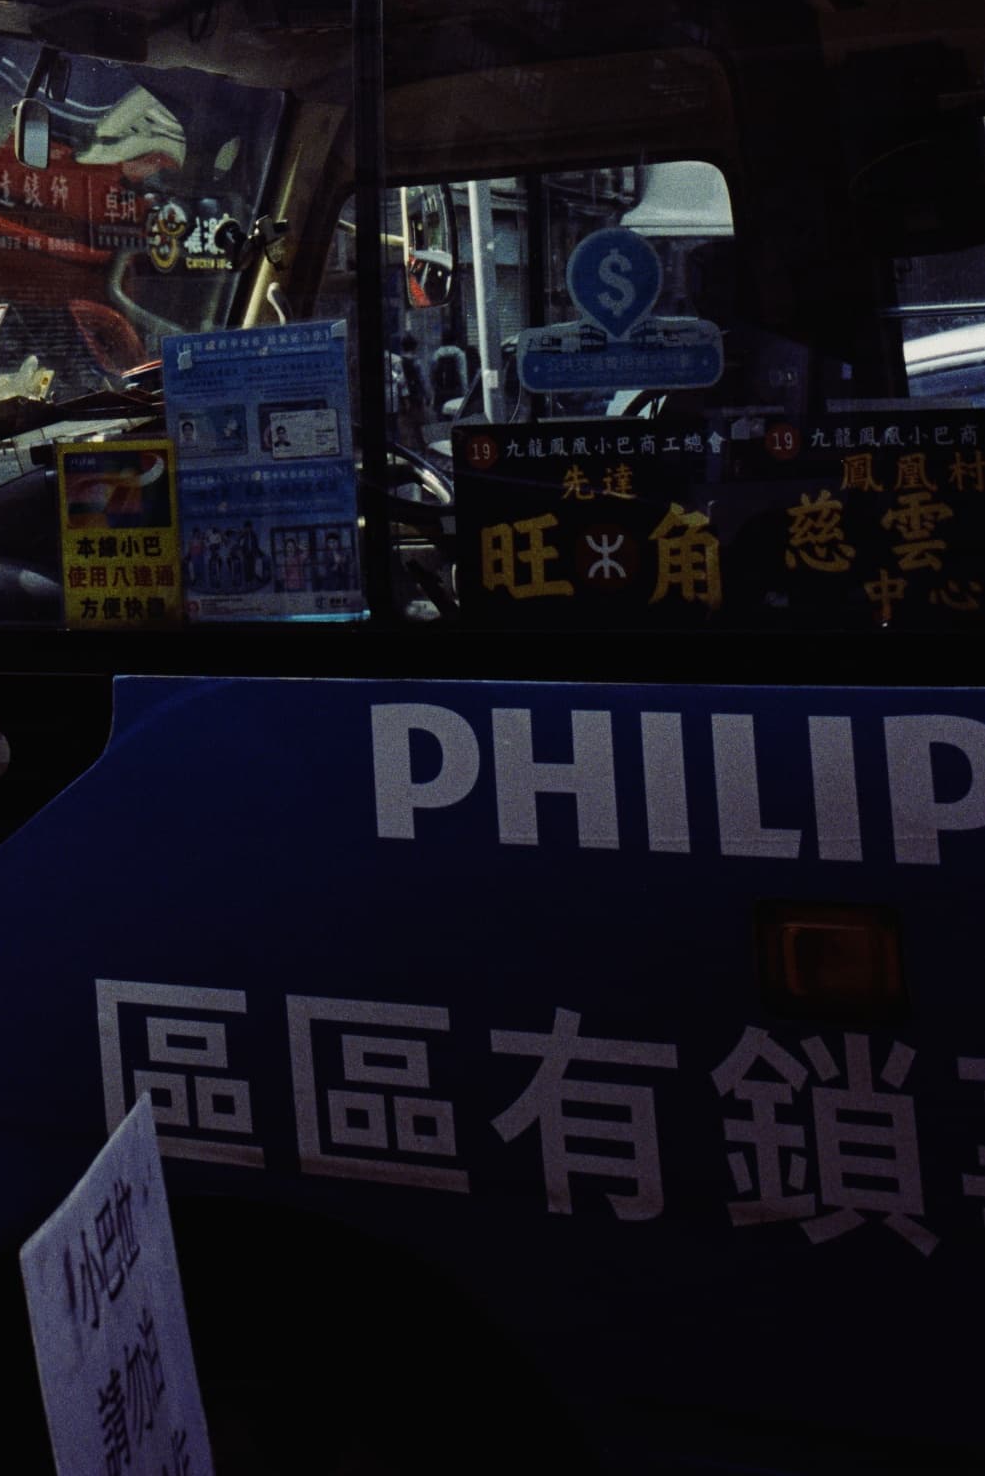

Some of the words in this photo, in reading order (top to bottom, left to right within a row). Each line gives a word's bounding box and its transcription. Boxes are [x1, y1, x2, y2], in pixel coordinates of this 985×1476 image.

[598, 248, 636, 317] $
[471, 442, 491, 461] 19
[771, 431, 794, 452] 19
[561, 464, 637, 501] 先達
[480, 512, 575, 600] 旺
[648, 501, 723, 611] 角
[784, 488, 954, 573] 慈雲
[863, 566, 984, 624] 中心
[369, 702, 985, 865] PHILIP
[94, 977, 985, 1260] 區區有鎖
